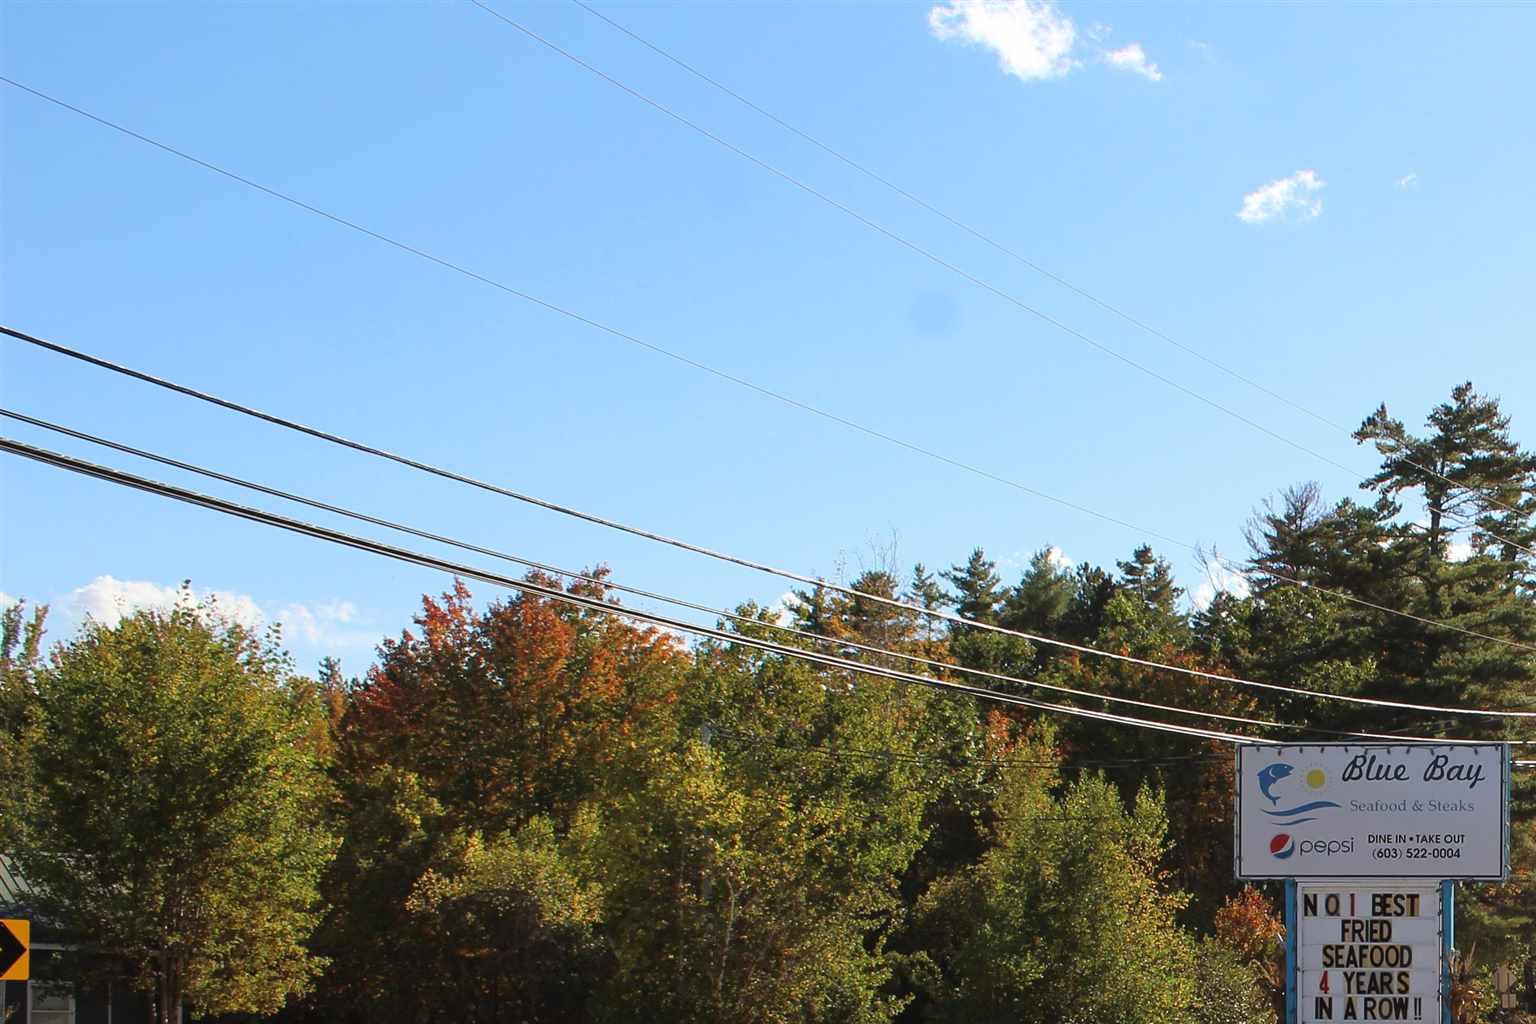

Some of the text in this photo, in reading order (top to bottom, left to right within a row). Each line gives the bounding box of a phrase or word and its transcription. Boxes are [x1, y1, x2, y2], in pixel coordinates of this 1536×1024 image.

[1342, 754, 1485, 789] Blue Bay
[1350, 800, 1475, 812] Seafood & Steaks
[1300, 837, 1355, 857] pepsi
[1368, 834, 1465, 844] DINE IN TAKE OUT
[1372, 848, 1461, 859] (603) 522-0004
[1372, 893, 1420, 916] BEST
[1341, 919, 1392, 942] FRIED
[1322, 944, 1413, 968] SEAFOOD
[1319, 970, 1410, 994] 4 YEARS
[1315, 997, 1333, 1020] IN
[1344, 997, 1357, 1020] A
